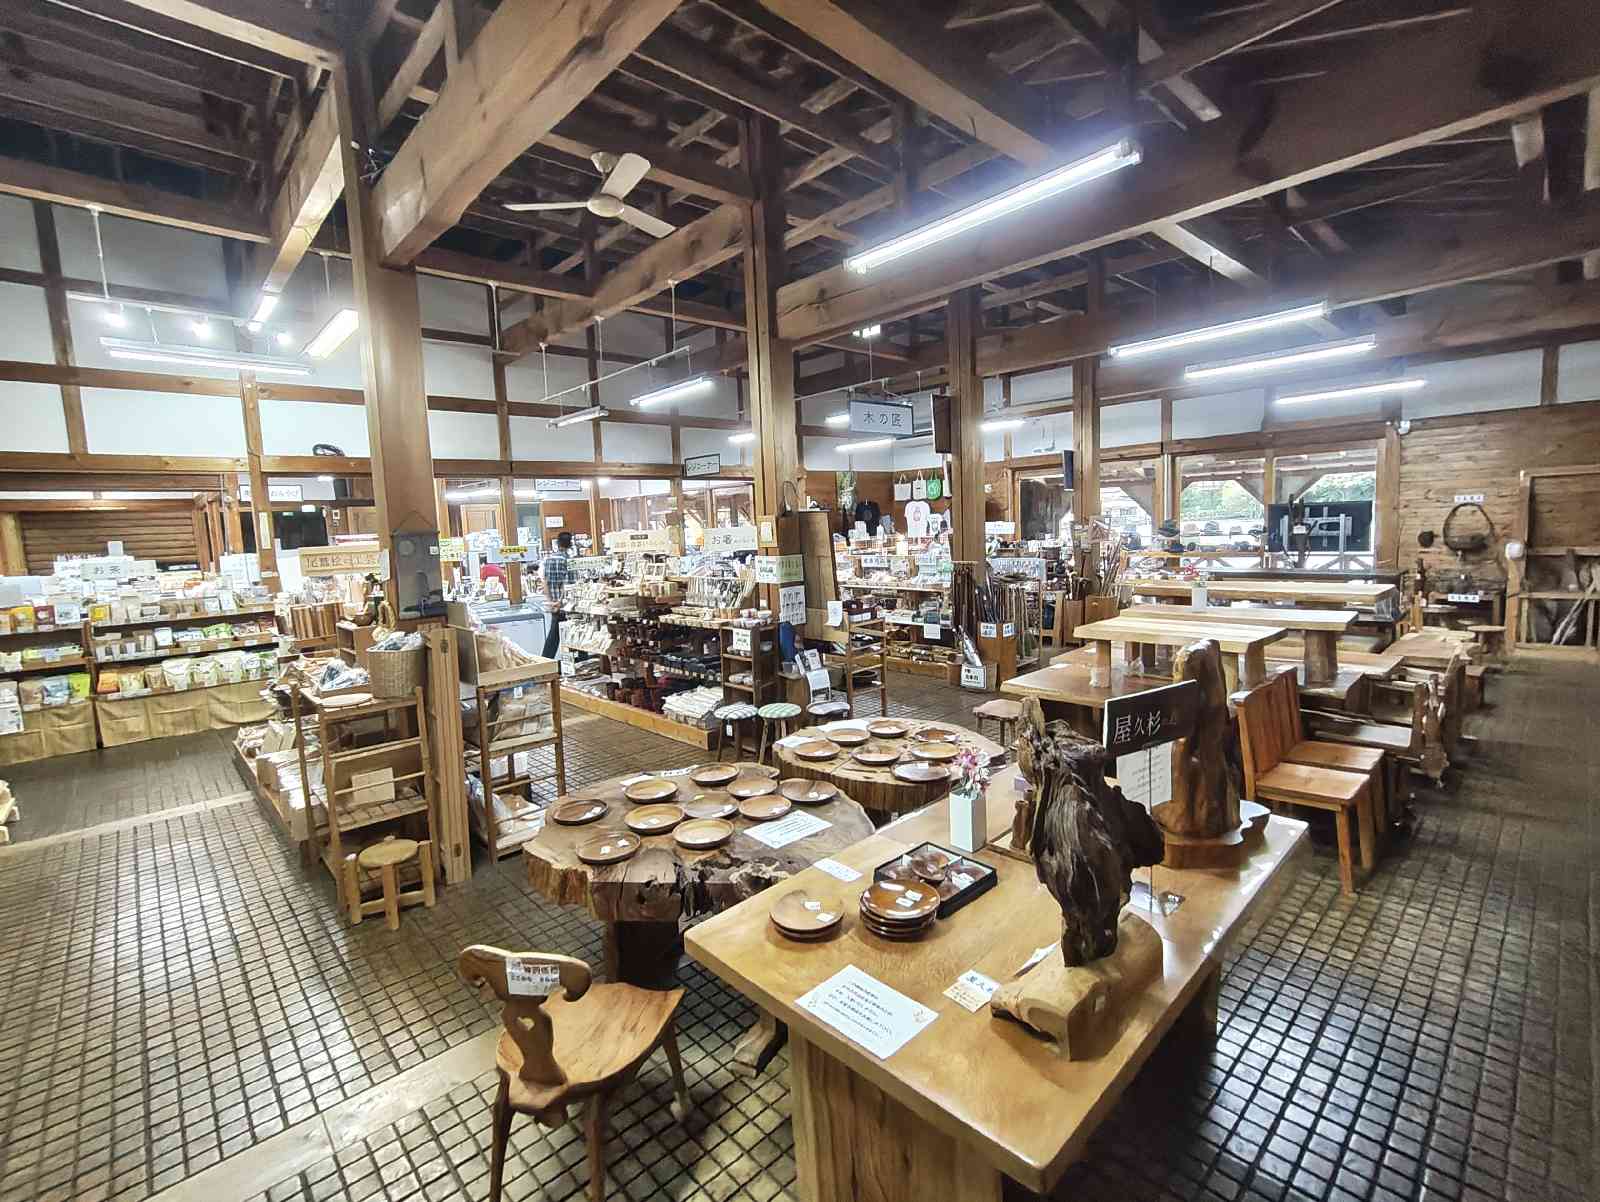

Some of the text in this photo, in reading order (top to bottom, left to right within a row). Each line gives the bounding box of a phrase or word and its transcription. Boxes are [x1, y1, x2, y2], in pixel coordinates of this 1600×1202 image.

[863, 409, 905, 427] 木の匠
[1113, 710, 1161, 745] 屋久杉
